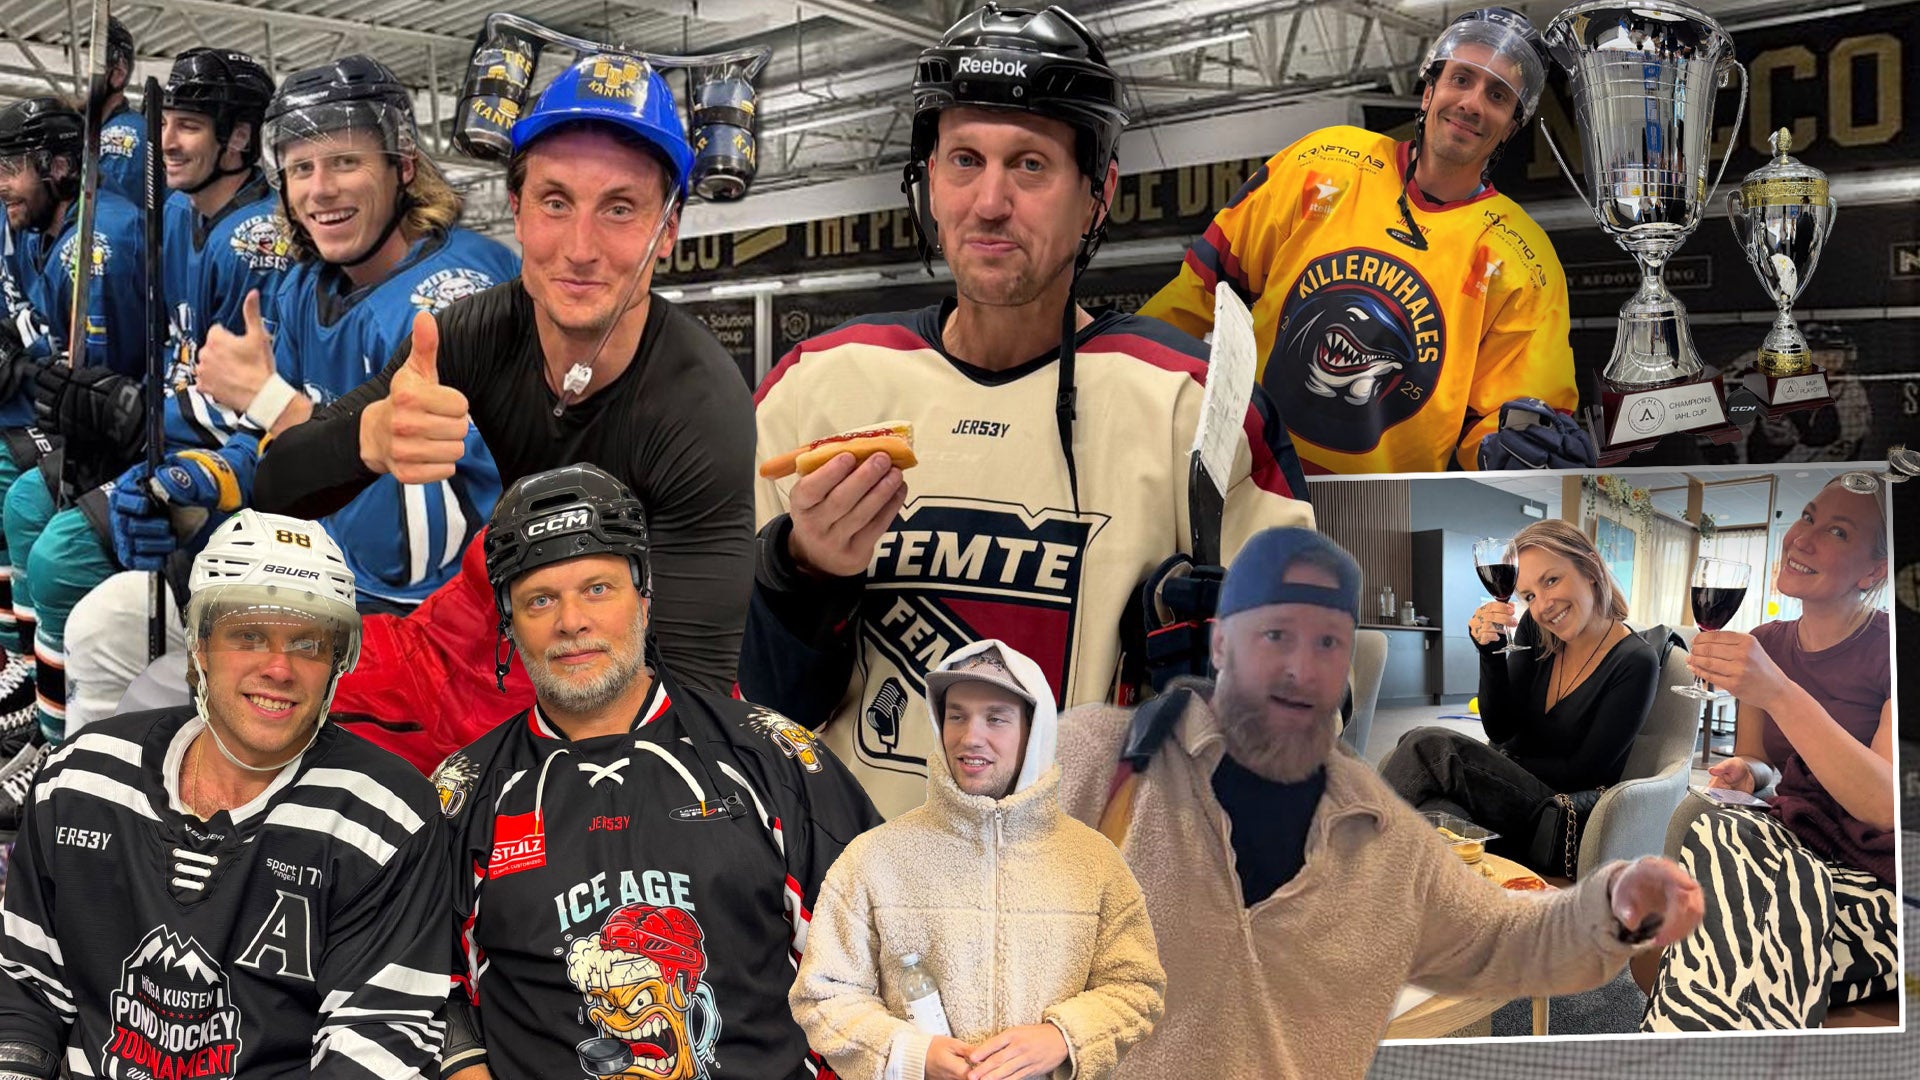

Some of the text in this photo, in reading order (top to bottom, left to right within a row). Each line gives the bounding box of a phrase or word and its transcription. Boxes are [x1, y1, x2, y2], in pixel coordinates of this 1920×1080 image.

[958, 56, 1028, 79] Reebok
[1299, 254, 1440, 364] KILLERWHALES
[712, 329, 744, 345] roup
[1401, 381, 1424, 401] 25
[1669, 396, 1712, 410] CHAMPIONS
[1692, 408, 1708, 418] CUP
[1730, 405, 1757, 413] CCM
[527, 513, 588, 537] CCM
[275, 529, 312, 549] 88
[263, 563, 320, 580] BAUER
[866, 530, 1079, 591] FEMTE
[55, 826, 112, 850] ER53Y
[491, 840, 542, 862] STULZ
[266, 858, 298, 876] sport
[273, 869, 297, 882] ringen
[554, 870, 696, 933] ICE AGE
[234, 889, 316, 981] A
[141, 975, 215, 1009] HÖGA KUSTEN
[116, 996, 235, 1053] POND HOCKEY
